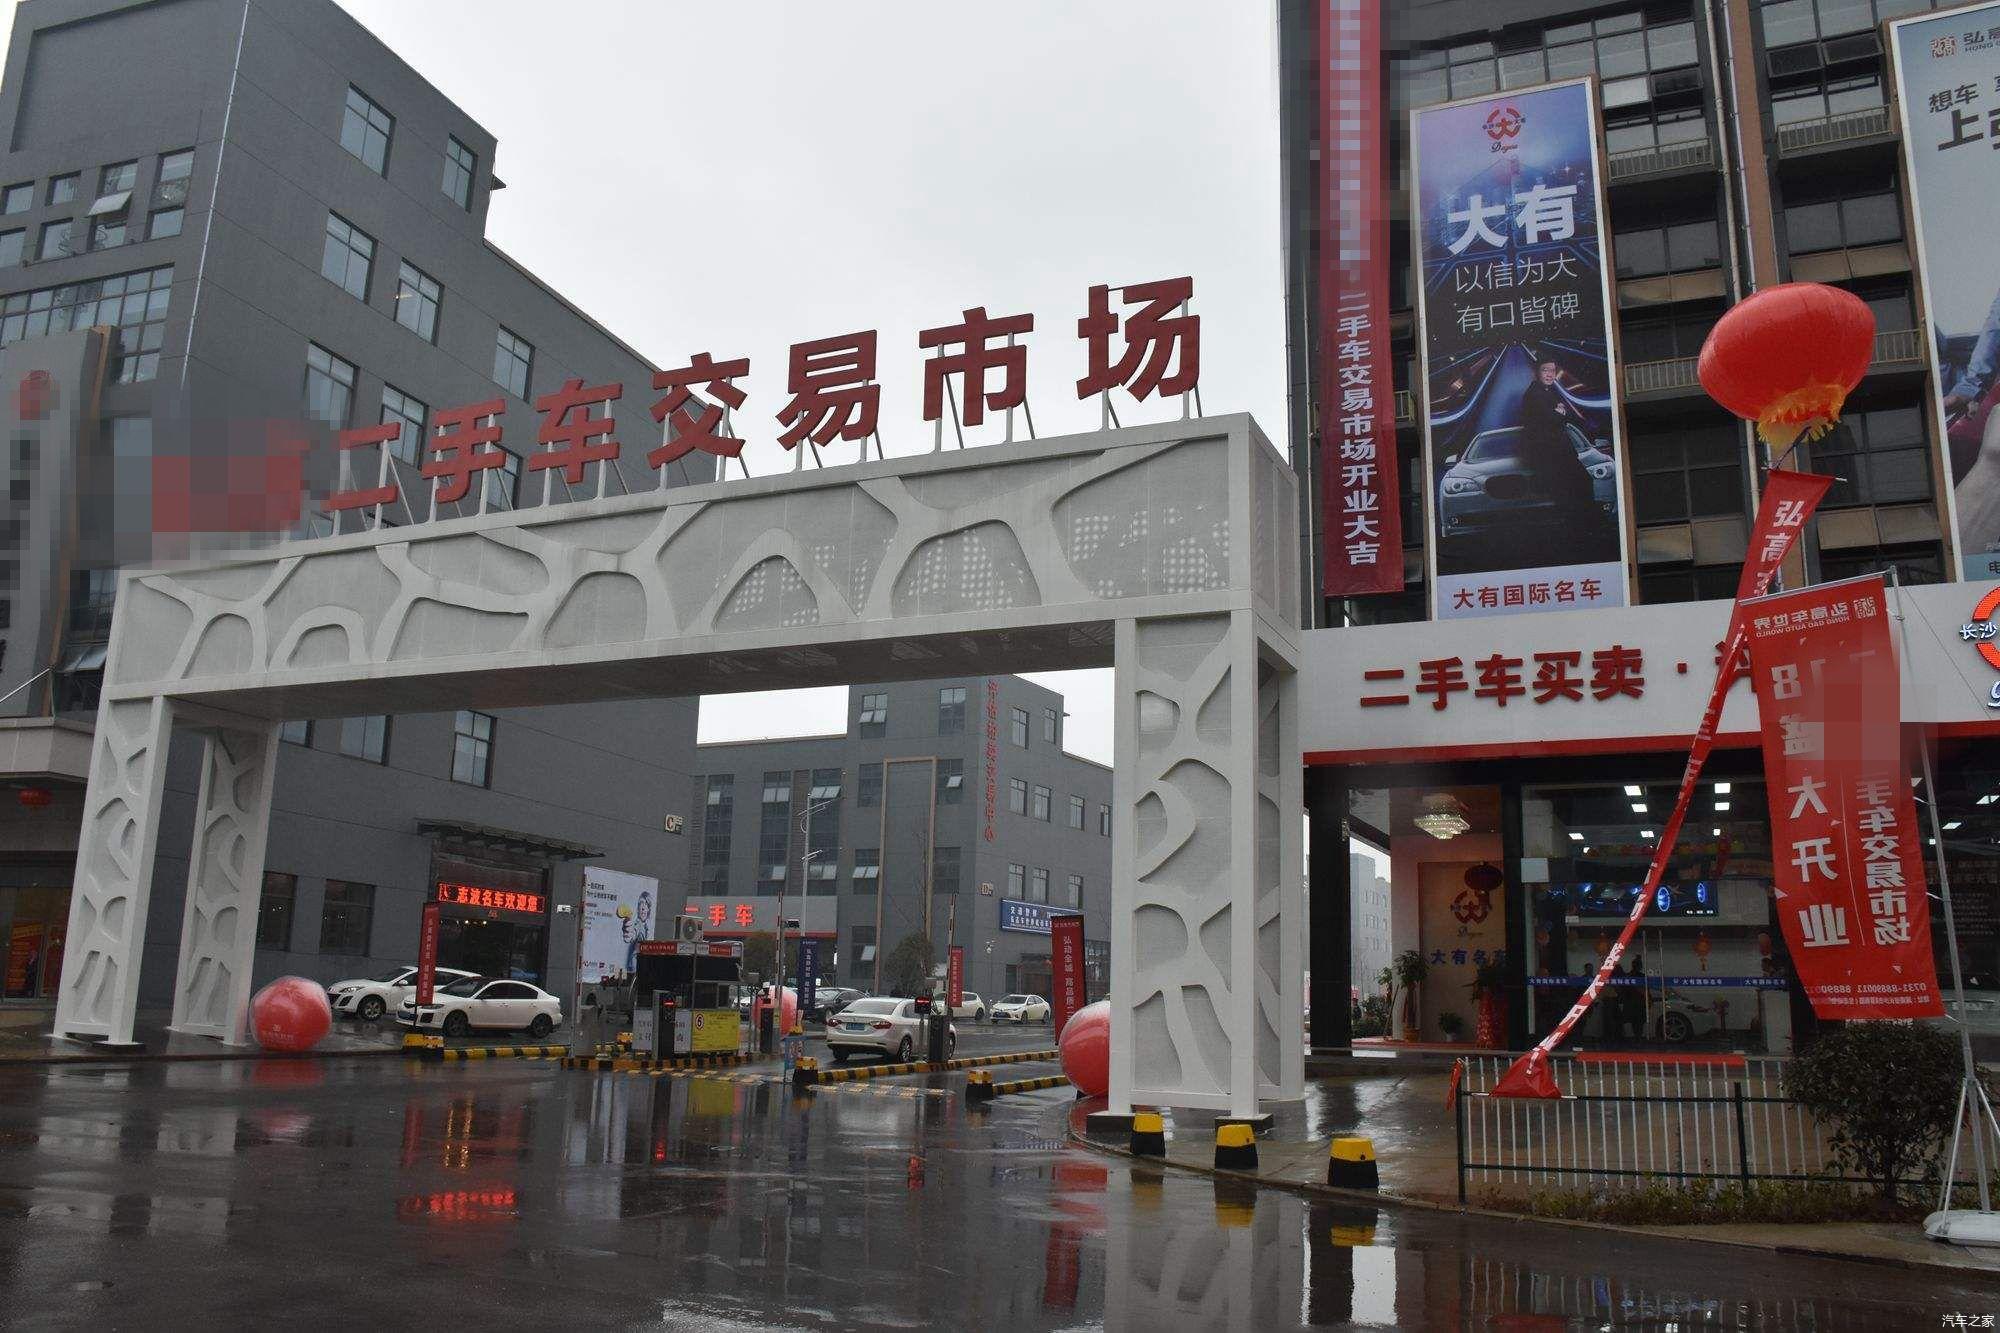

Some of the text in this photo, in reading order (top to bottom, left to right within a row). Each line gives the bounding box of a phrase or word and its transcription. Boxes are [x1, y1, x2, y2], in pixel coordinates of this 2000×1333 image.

[1929, 83, 1979, 113] 想车
[1445, 183, 1579, 254] 大有
[1455, 257, 1578, 291] 以信为大
[1456, 293, 1581, 333] 有口皆碑
[322, 276, 1201, 512] 二手车交易市场
[1335, 291, 1382, 566] 二手车交易市场开业大吉
[1453, 578, 1603, 609] 大有国际名车
